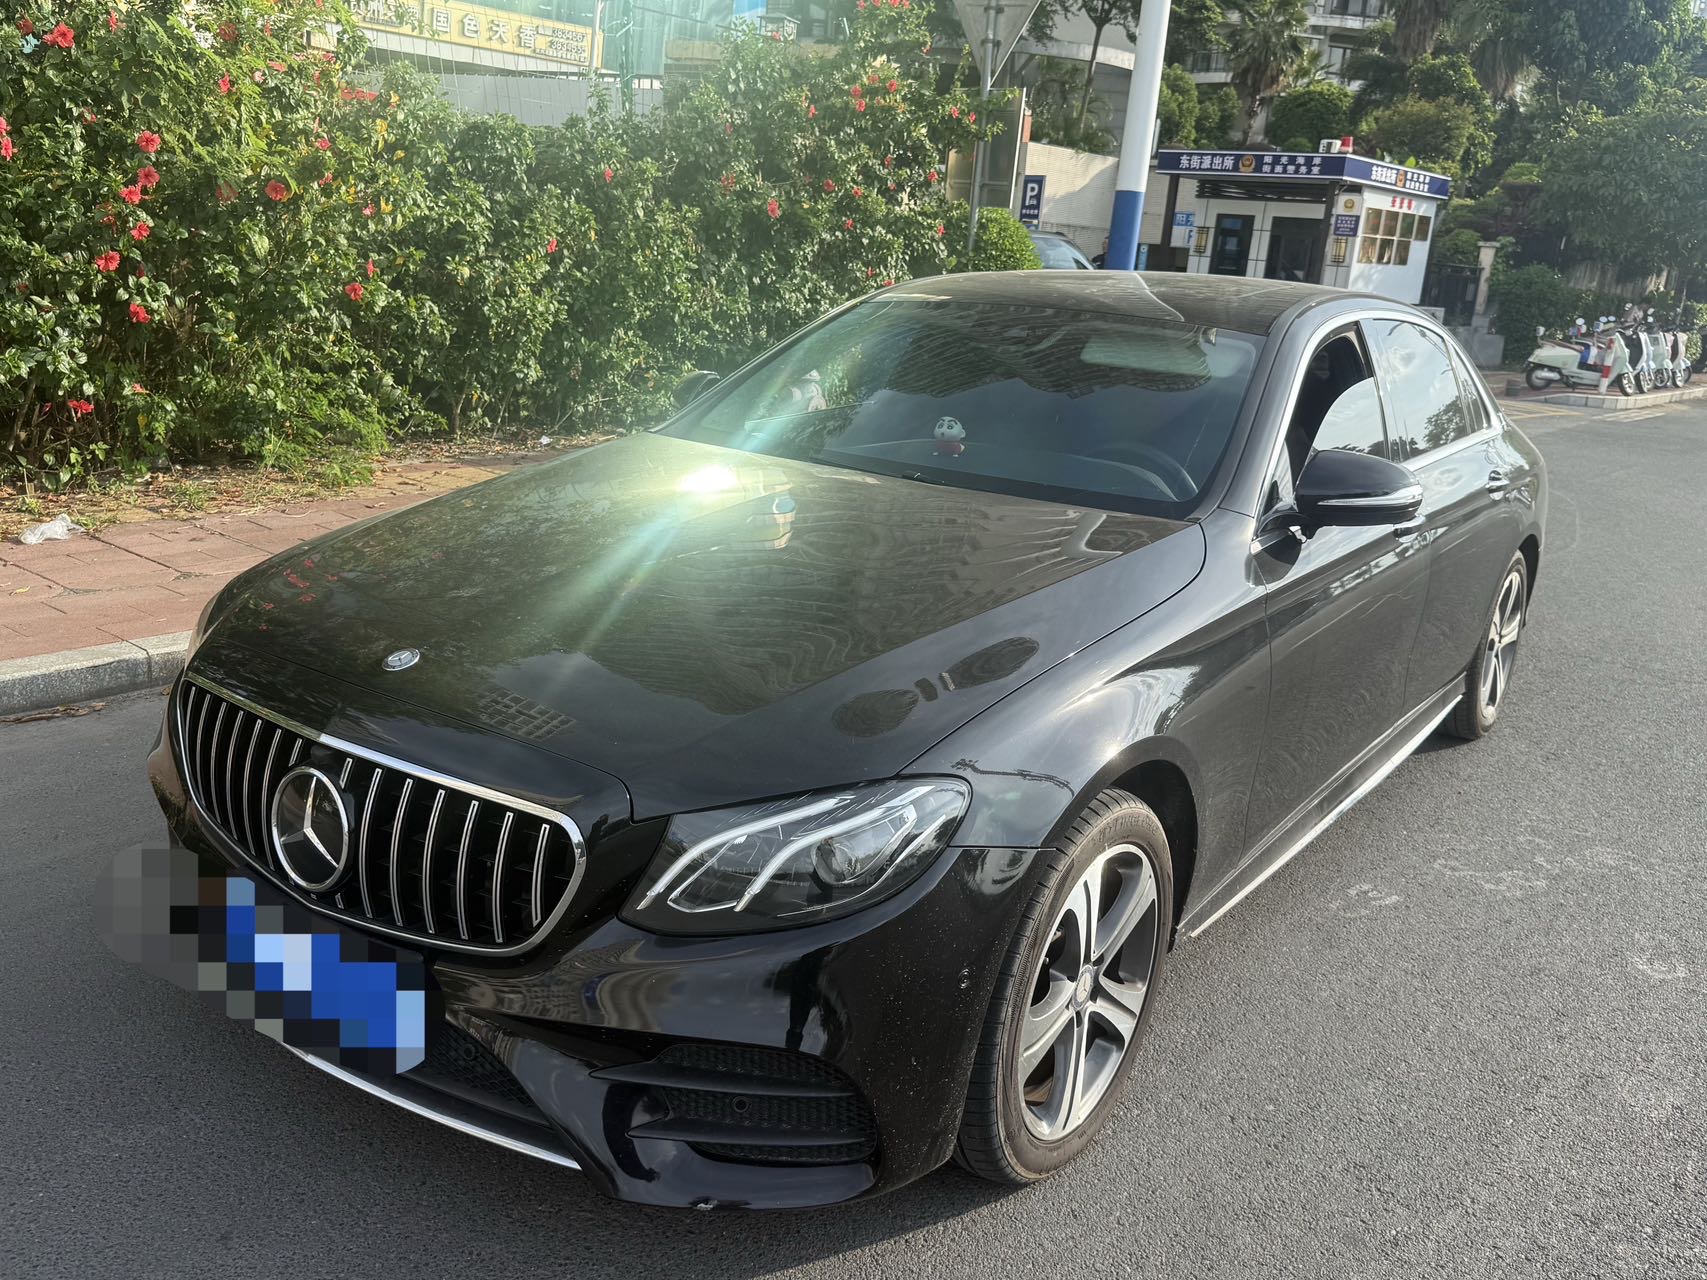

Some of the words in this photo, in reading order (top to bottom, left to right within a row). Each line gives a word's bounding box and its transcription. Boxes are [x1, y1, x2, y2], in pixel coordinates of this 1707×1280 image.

[432, 8, 537, 48] 国色天香
[1179, 154, 1235, 170] 东街派出所
[1263, 155, 1322, 165] 阳光海岸
[1261, 164, 1321, 175] 街面警务室
[1025, 183, 1039, 206] P
